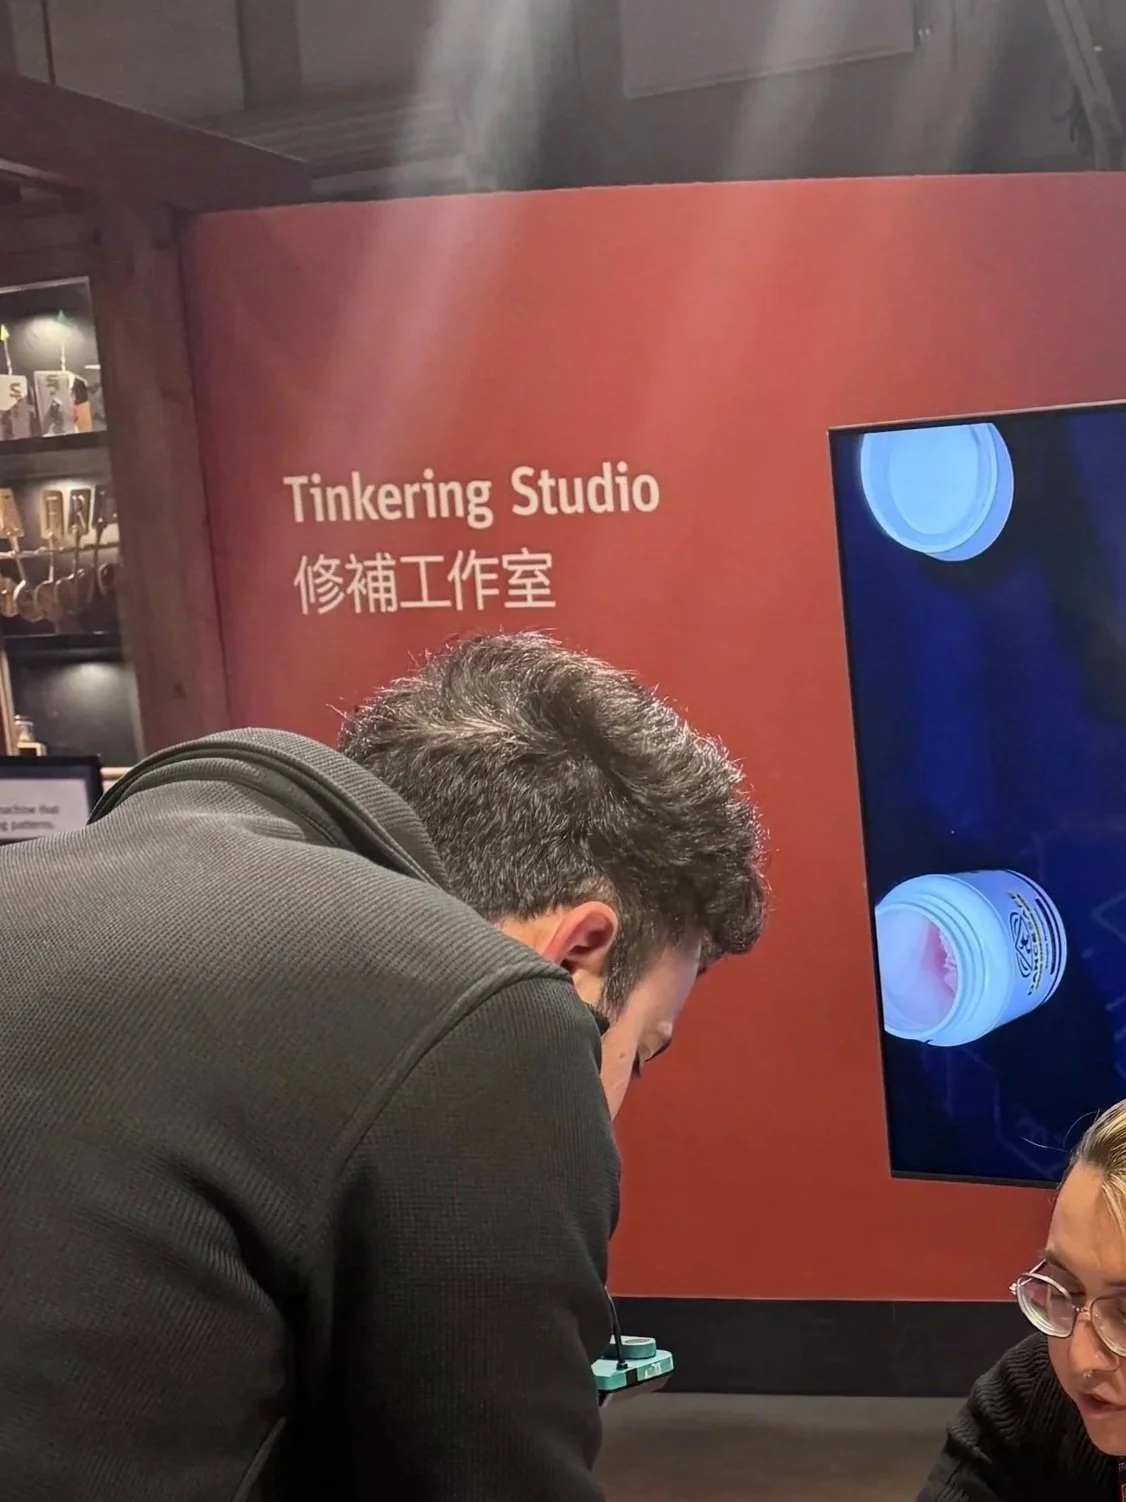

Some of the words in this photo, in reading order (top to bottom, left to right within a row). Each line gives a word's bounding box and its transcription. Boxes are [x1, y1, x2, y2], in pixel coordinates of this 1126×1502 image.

[283, 468, 494, 529] Tinkering
[511, 461, 660, 516] Studio
[294, 547, 556, 615] 修補工作室
